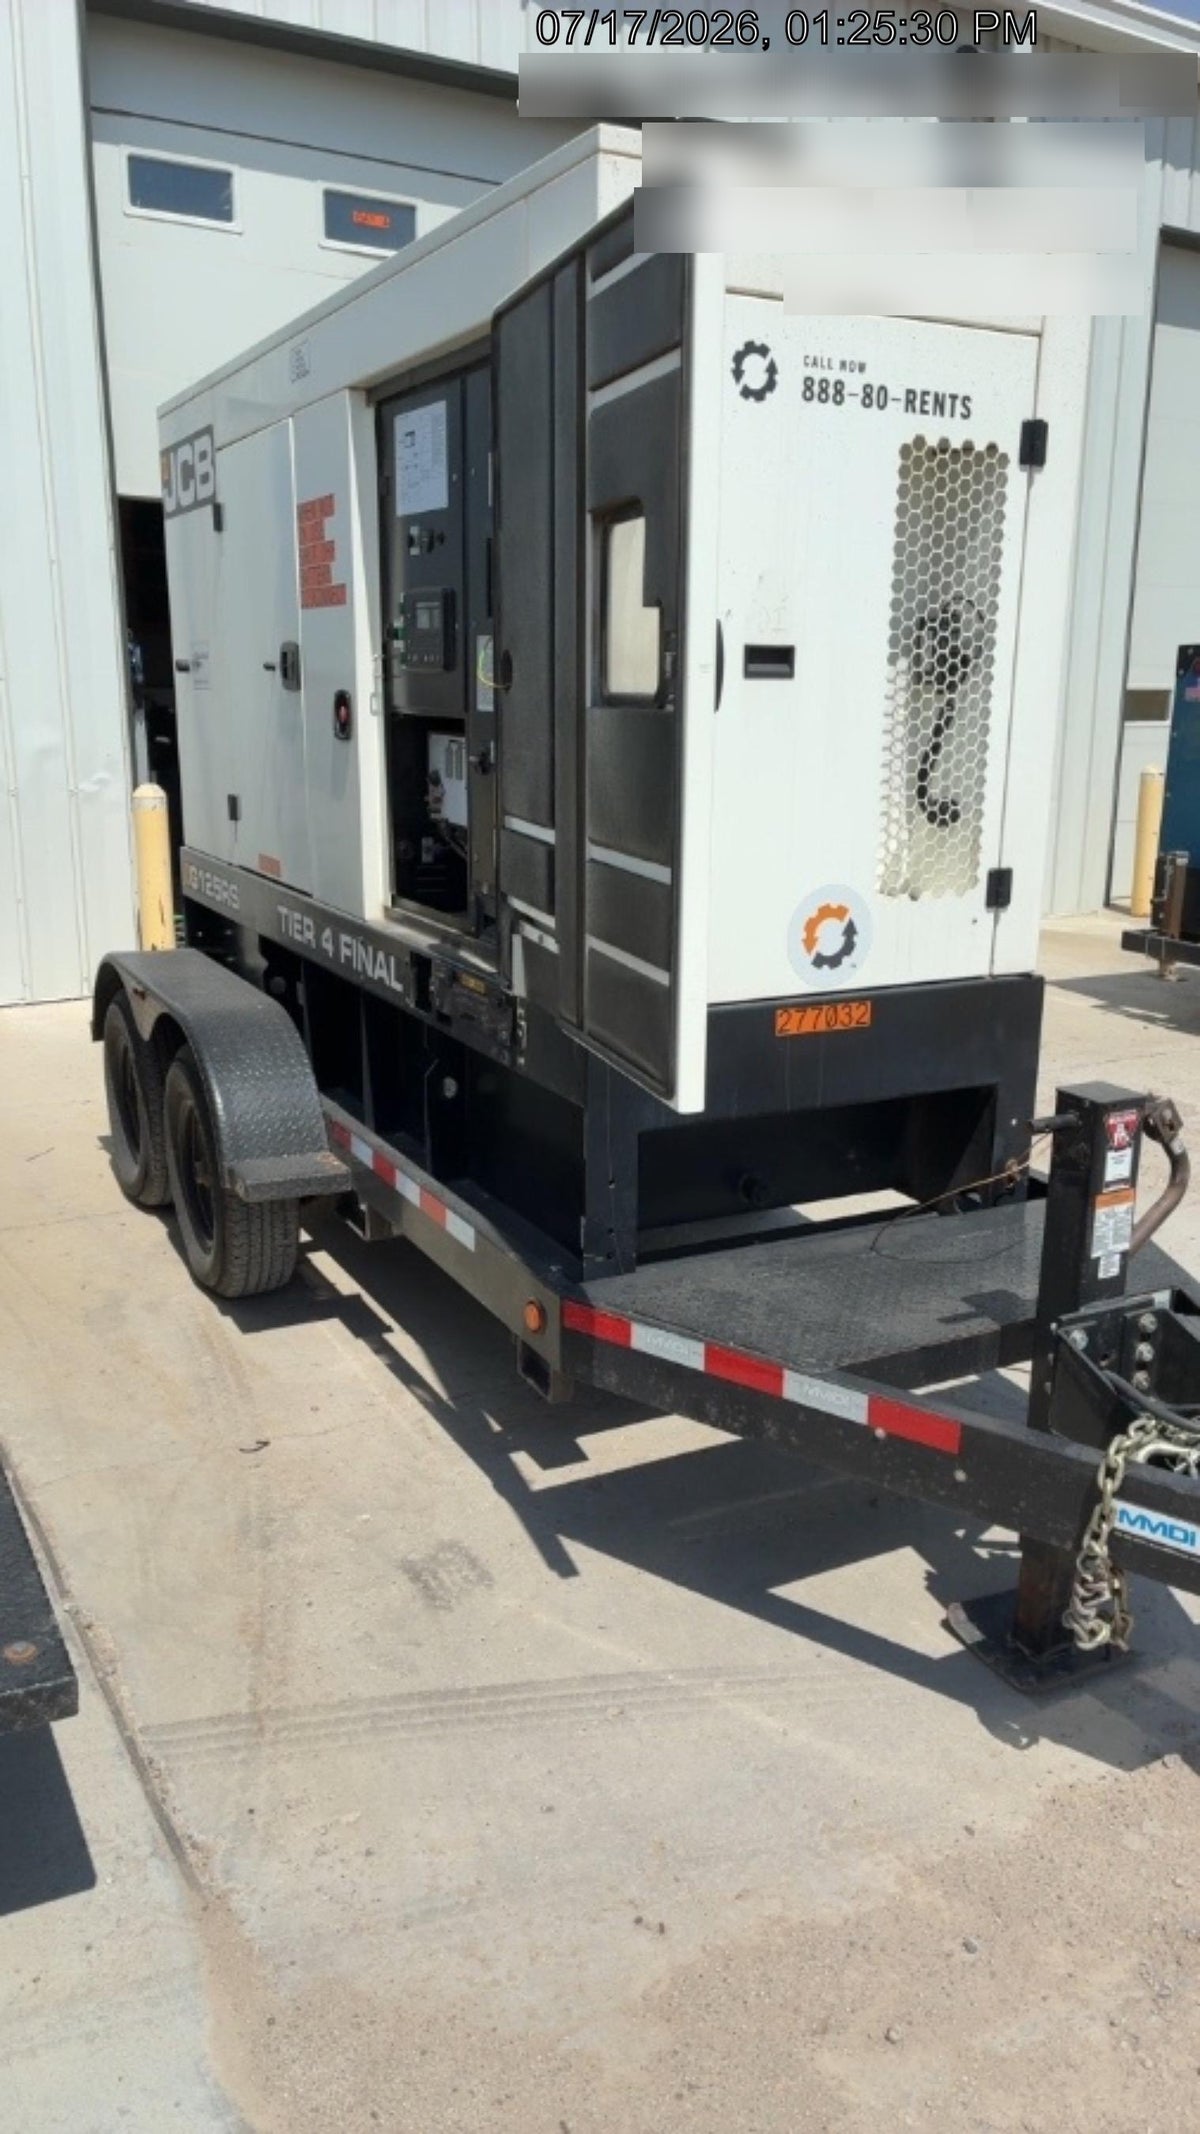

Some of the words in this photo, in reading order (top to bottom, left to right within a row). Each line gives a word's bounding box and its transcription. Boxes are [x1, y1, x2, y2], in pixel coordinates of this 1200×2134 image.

[803, 355, 834, 371] CALL
[839, 360, 867, 374] NOW
[802, 376, 972, 420] 888-80-RENTS
[163, 433, 216, 514] JCB
[277, 904, 317, 949] TIER
[321, 927, 334, 958] 4
[339, 933, 404, 992] FINAL
[778, 1002, 869, 1034] 277032
[1118, 1508, 1197, 1547] MMDI
